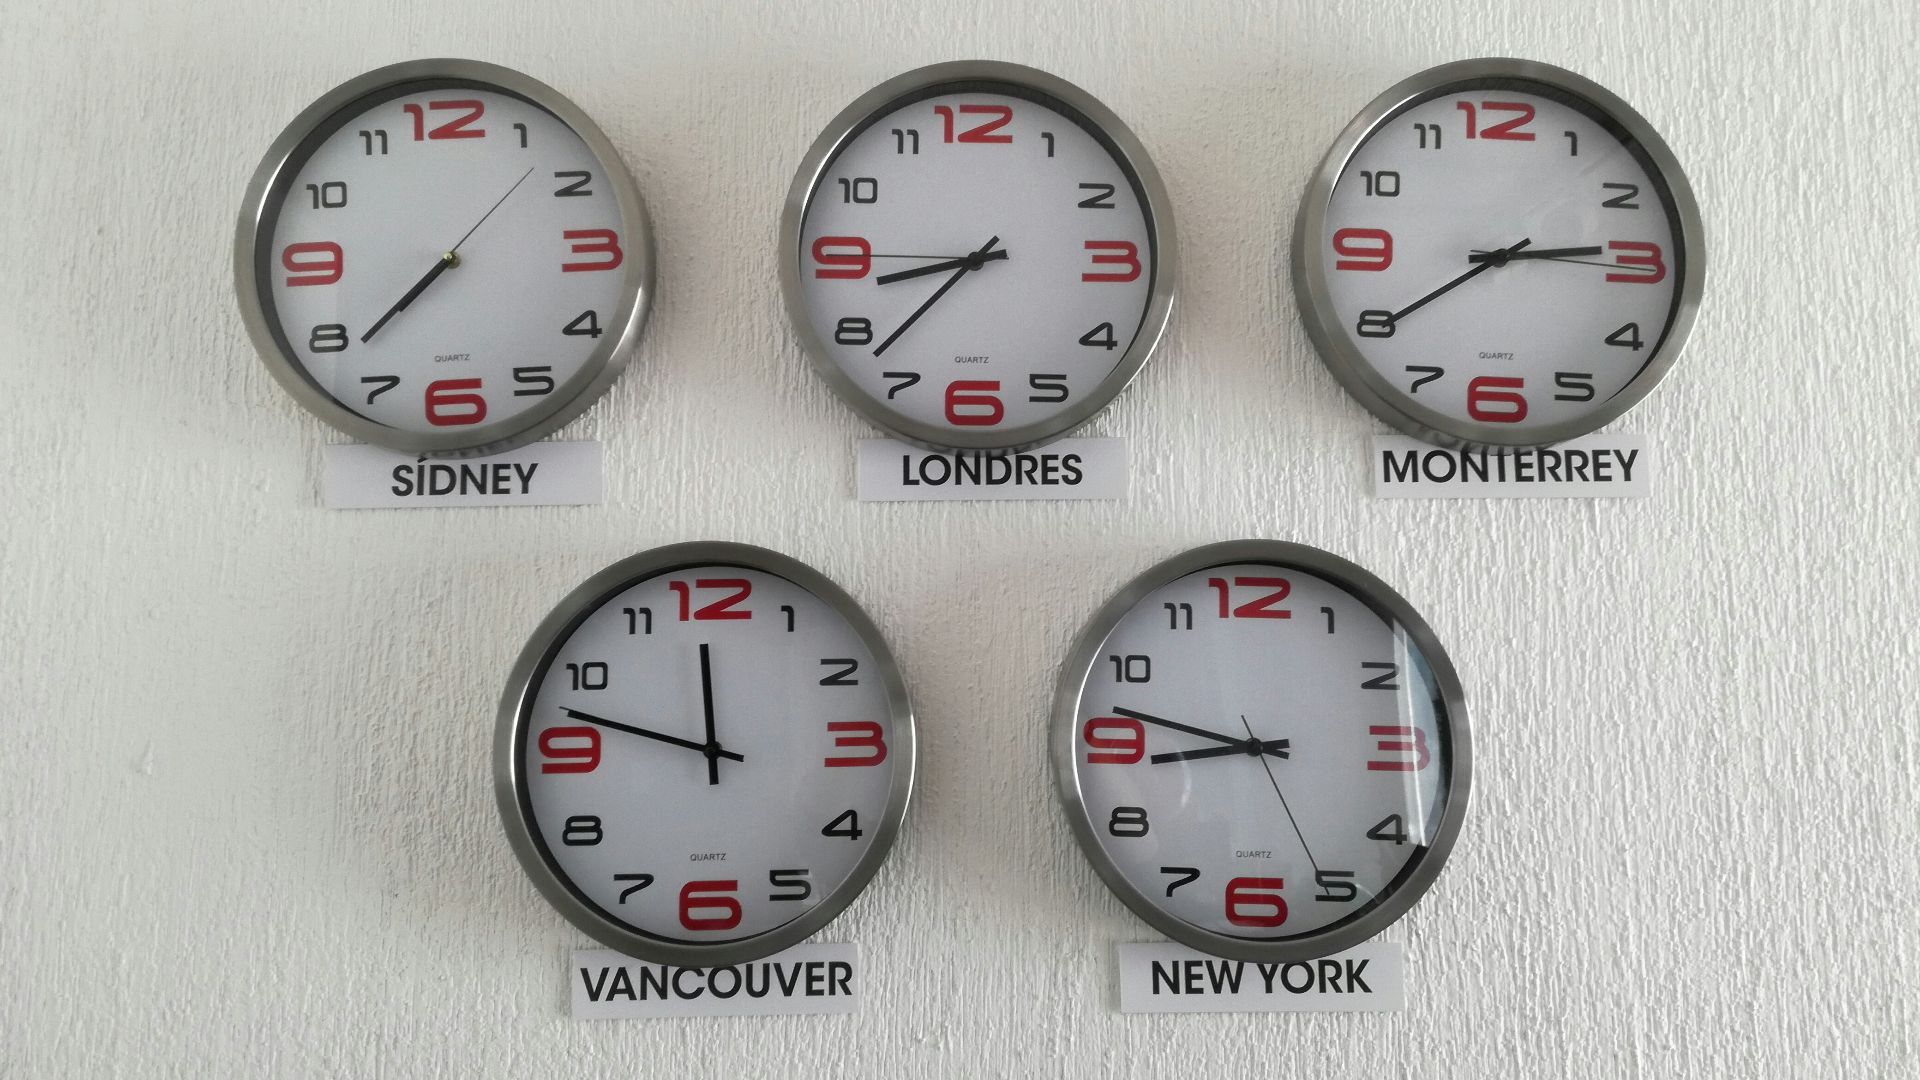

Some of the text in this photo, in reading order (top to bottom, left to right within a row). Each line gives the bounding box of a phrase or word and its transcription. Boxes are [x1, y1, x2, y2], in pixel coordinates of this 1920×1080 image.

[404, 100, 485, 141] 12
[514, 123, 528, 148] 1
[934, 105, 1013, 143] 12
[1457, 101, 1536, 141] 12
[359, 130, 388, 155] 11
[892, 128, 919, 155] 11
[1041, 132, 1054, 157] 1
[1414, 123, 1442, 149] 11
[1564, 131, 1578, 156] 1
[307, 181, 347, 209] 10
[554, 170, 593, 197] 2
[838, 177, 878, 203] 10
[1078, 182, 1115, 209] 2
[1360, 170, 1400, 197] 10
[1602, 182, 1639, 209] 2
[282, 241, 343, 287] 9
[562, 229, 623, 272] 3
[812, 236, 871, 279] 9
[1081, 241, 1142, 282] 3
[1333, 228, 1393, 272] 9
[1606, 241, 1666, 284] 3
[309, 324, 349, 353] 8
[562, 310, 602, 338] 4
[835, 317, 873, 345] 8
[1078, 322, 1118, 350] 4
[1357, 310, 1396, 338] 8
[1604, 322, 1643, 351] 4
[434, 353, 470, 363] QUARTZ
[954, 356, 989, 364] QUARTZ
[1478, 352, 1514, 360] QUARTZ
[361, 376, 400, 404] 7
[513, 366, 554, 396] 5
[883, 371, 921, 400] 7
[1029, 374, 1069, 403] 5
[1405, 365, 1445, 393] 7
[1554, 371, 1595, 402] 5
[425, 378, 487, 426] 6
[944, 380, 1004, 426] 6
[1467, 376, 1528, 423] 6
[902, 454, 1083, 486] LONDRES
[1383, 449, 1639, 483] MONTERREY
[669, 579, 752, 622] 12
[1208, 577, 1291, 620] 12
[623, 607, 652, 635] 11
[781, 605, 795, 632] 1
[1164, 602, 1193, 630] 11
[1321, 607, 1335, 634] 1
[566, 661, 608, 691] 10
[819, 658, 859, 686] 2
[1109, 655, 1151, 683] 10
[1361, 661, 1400, 690] 2
[538, 726, 601, 774] 9
[824, 721, 888, 768] 3
[1083, 717, 1145, 765] 9
[1367, 725, 1431, 772] 3
[562, 815, 603, 846] 8
[821, 809, 863, 841] 4
[1109, 806, 1149, 838] 8
[1366, 813, 1407, 845] 4
[690, 853, 727, 862] QUARTZ
[1236, 850, 1273, 859] QUARTZ
[613, 873, 654, 904] 7
[769, 869, 812, 902] 5
[1160, 866, 1200, 897] 7
[1315, 871, 1358, 902] 5
[679, 880, 742, 931] 6
[1225, 877, 1289, 927] 6
[580, 961, 853, 1002] VANCOUVER
[1152, 959, 1373, 995] NEW YORK
